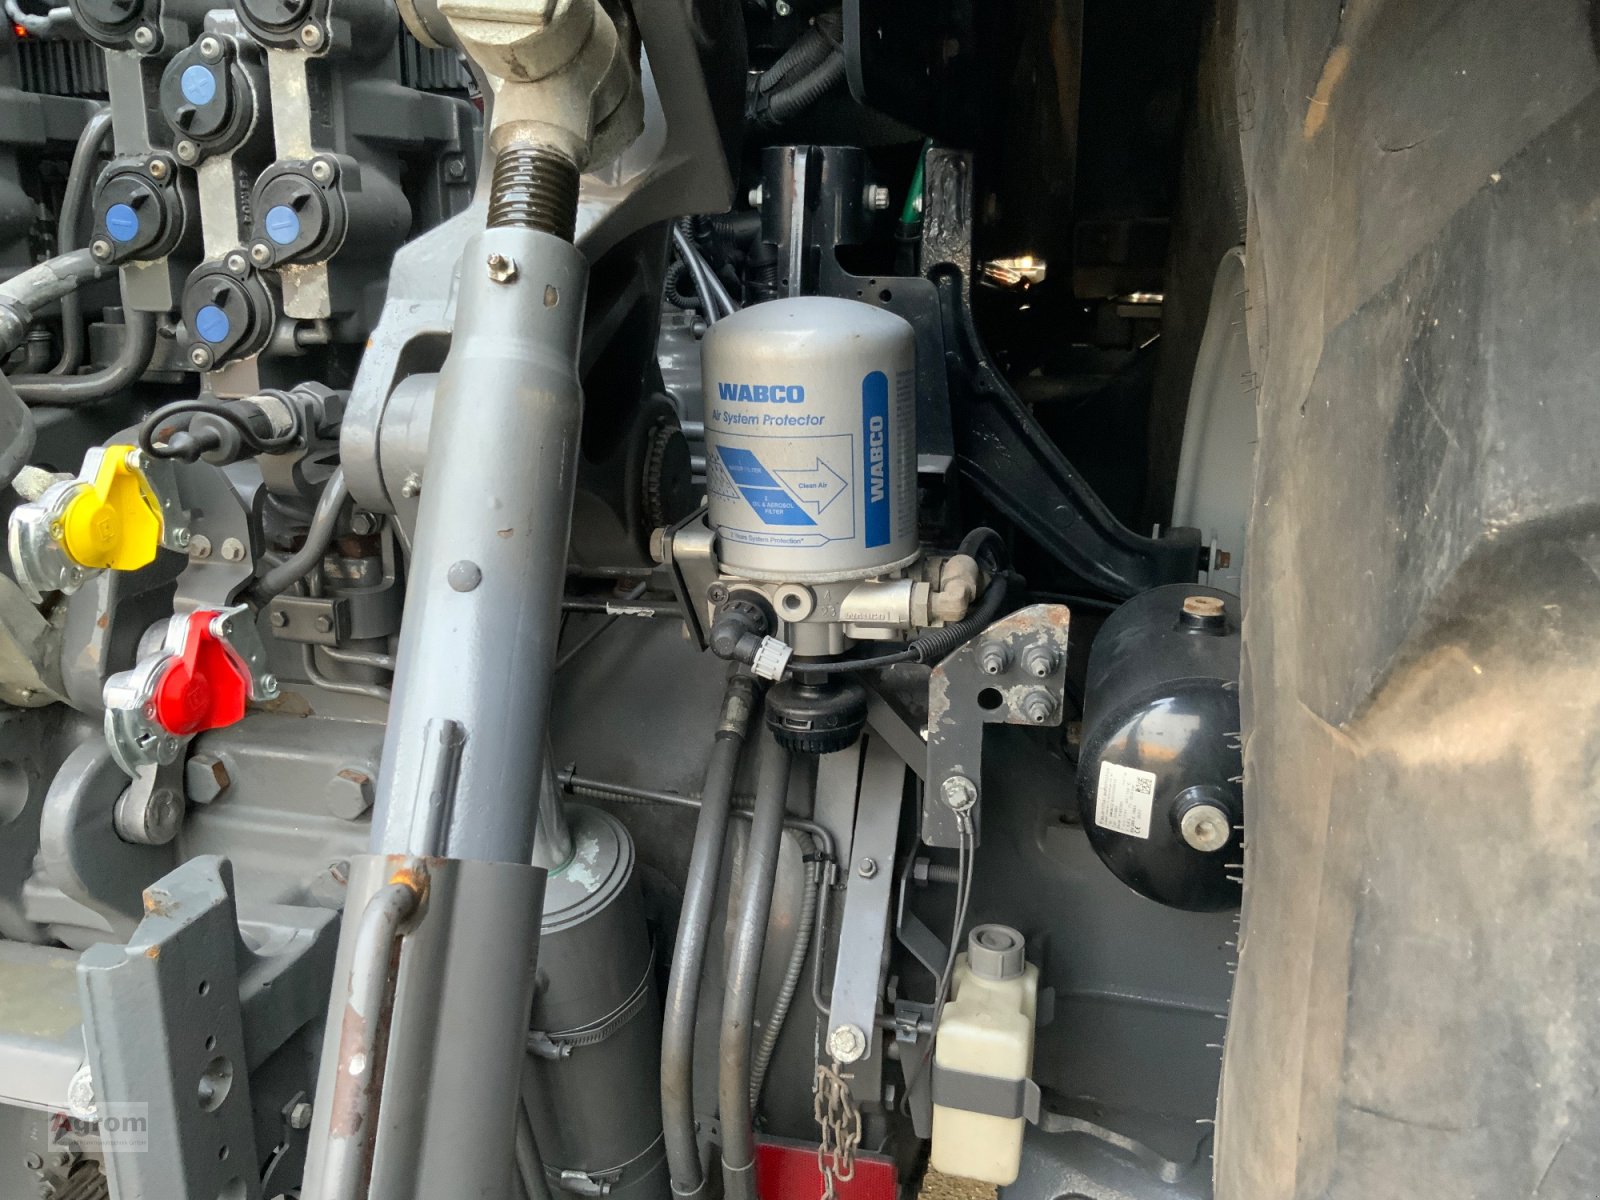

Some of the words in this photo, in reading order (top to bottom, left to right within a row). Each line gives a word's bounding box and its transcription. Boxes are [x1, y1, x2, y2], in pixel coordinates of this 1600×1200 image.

[718, 382, 805, 404] WABCO
[712, 409, 721, 421] Air
[723, 411, 759, 425] System
[763, 414, 825, 426] Protector
[870, 416, 884, 503] WABCO
